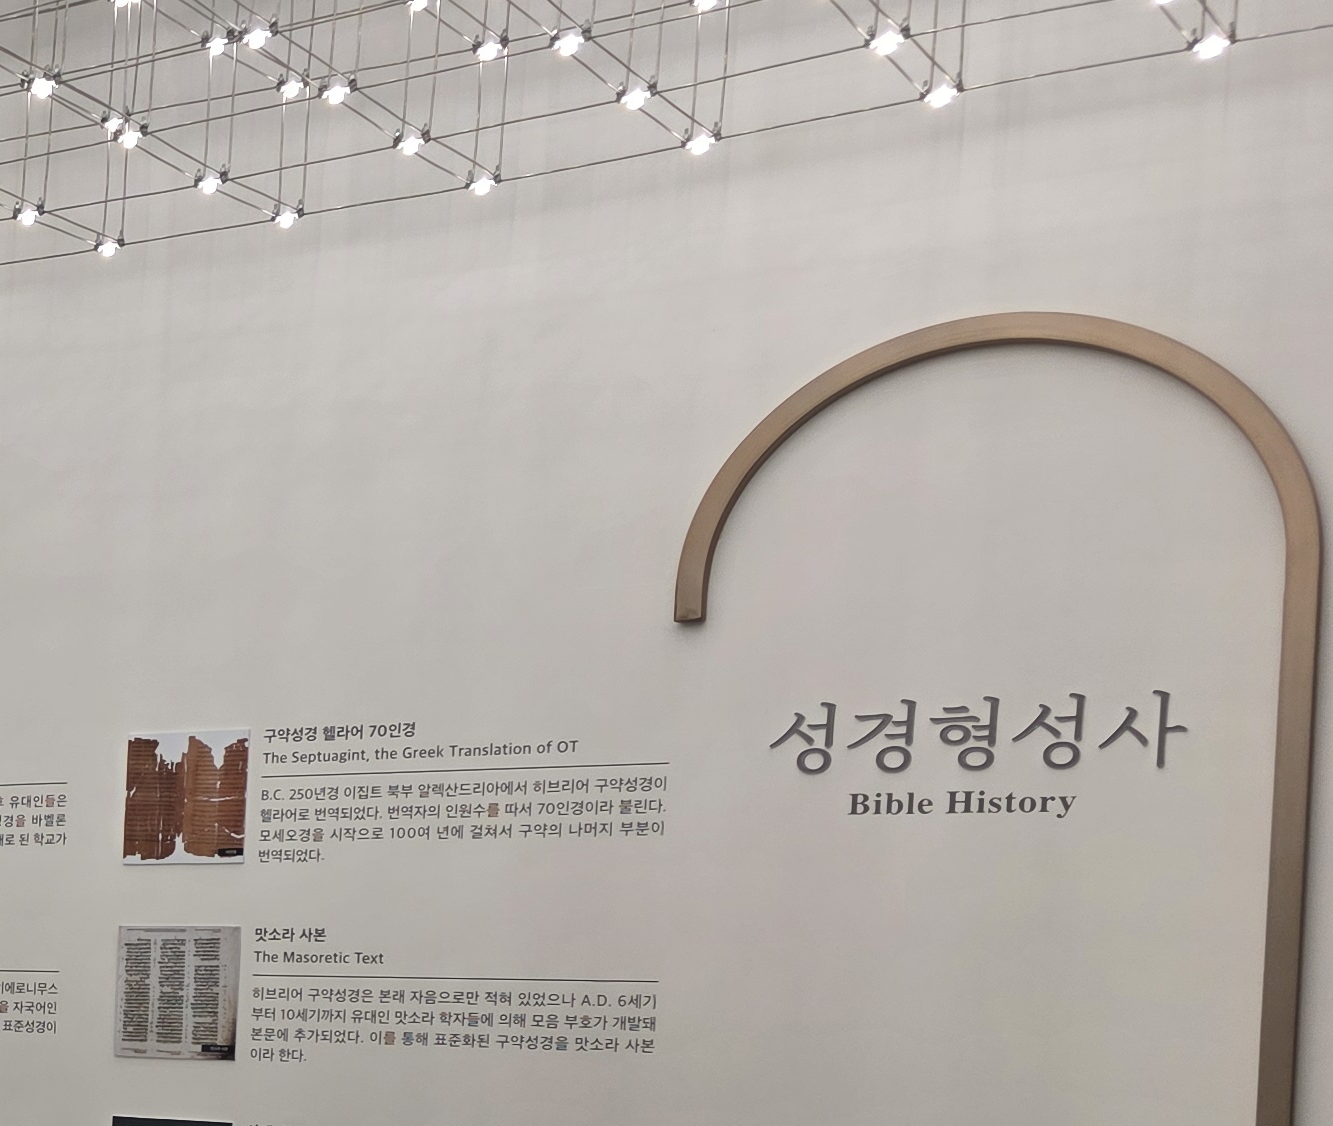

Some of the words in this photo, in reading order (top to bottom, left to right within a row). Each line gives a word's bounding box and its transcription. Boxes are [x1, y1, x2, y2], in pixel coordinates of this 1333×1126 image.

[263, 726, 317, 744] 구약성경
[369, 721, 416, 738] 70인경
[769, 689, 1188, 776] 성경형성사
[263, 751, 288, 764] The
[291, 749, 370, 765] Septuagint,
[374, 747, 398, 760] the
[402, 745, 444, 759] Greek
[449, 742, 531, 757] Translation
[537, 740, 553, 754] of
[557, 740, 579, 753] OT
[261, 789, 284, 801] B.C.
[289, 786, 339, 801] 250년경
[344, 785, 383, 800] 이집트
[387, 784, 413, 799] 북부
[418, 780, 527, 798] 알렉산드리아에서
[533, 778, 589, 795] 히브리어
[594, 776, 667, 793] 구약성경이
[314, 805, 382, 822] 번역되었다.
[387, 804, 440, 820] 번역자의
[445, 802, 500, 819] 인원수를
[505, 802, 532, 817] 따서
[537, 799, 614, 816] 70인경이라
[618, 798, 666, 815] 불린다.
[847, 791, 934, 816] Bible
[946, 790, 1077, 819] History
[259, 828, 324, 843] 모세오경을
[329, 827, 384, 842] 시작으로
[390, 825, 430, 840] 100여
[437, 824, 464, 840] 년에
[470, 823, 512, 839] 걸쳐서
[518, 822, 562, 838] 구약의
[569, 821, 612, 837] 나머지
[619, 821, 664, 836] 부분이
[258, 848, 325, 863] 번역되었다.
[255, 927, 295, 942] 맛소라
[299, 927, 327, 943] 사본
[253, 950, 278, 963] The
[283, 951, 350, 964] Masoretic
[354, 952, 384, 964] Text
